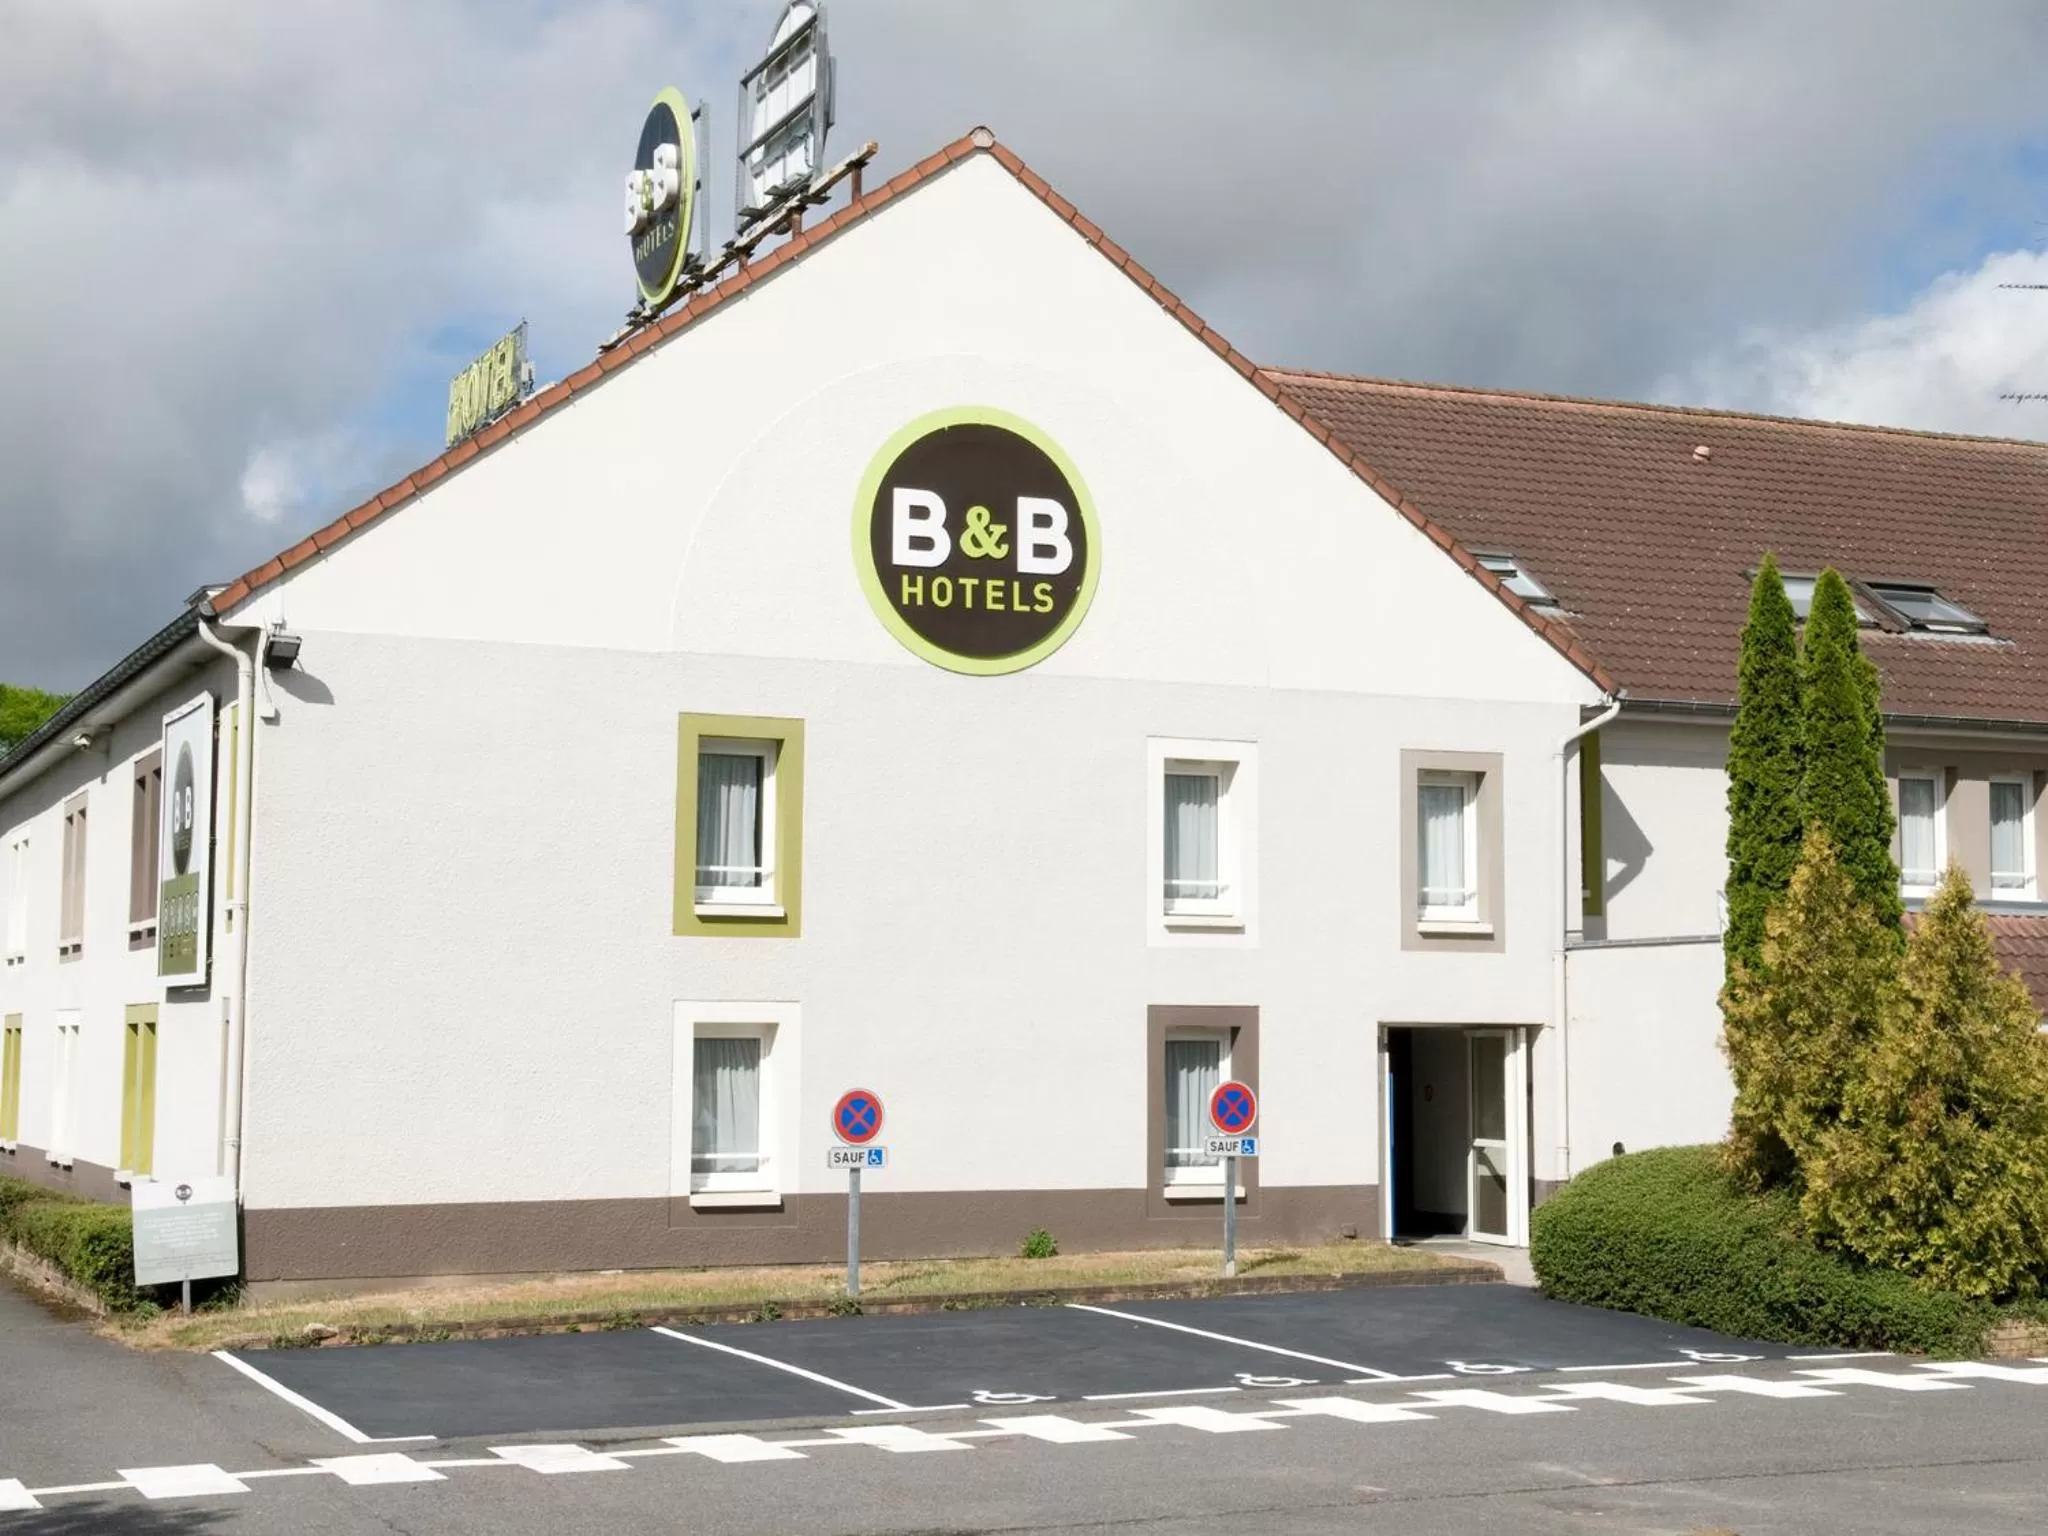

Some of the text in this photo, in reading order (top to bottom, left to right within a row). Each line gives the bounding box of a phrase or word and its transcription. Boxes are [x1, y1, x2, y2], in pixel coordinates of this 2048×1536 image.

[892, 487, 1073, 575] B&B
[901, 574, 1054, 613] HOTELS
[174, 786, 192, 833] BB
[833, 1151, 865, 1163] SAUF
[1209, 1140, 1239, 1152] SAUF
